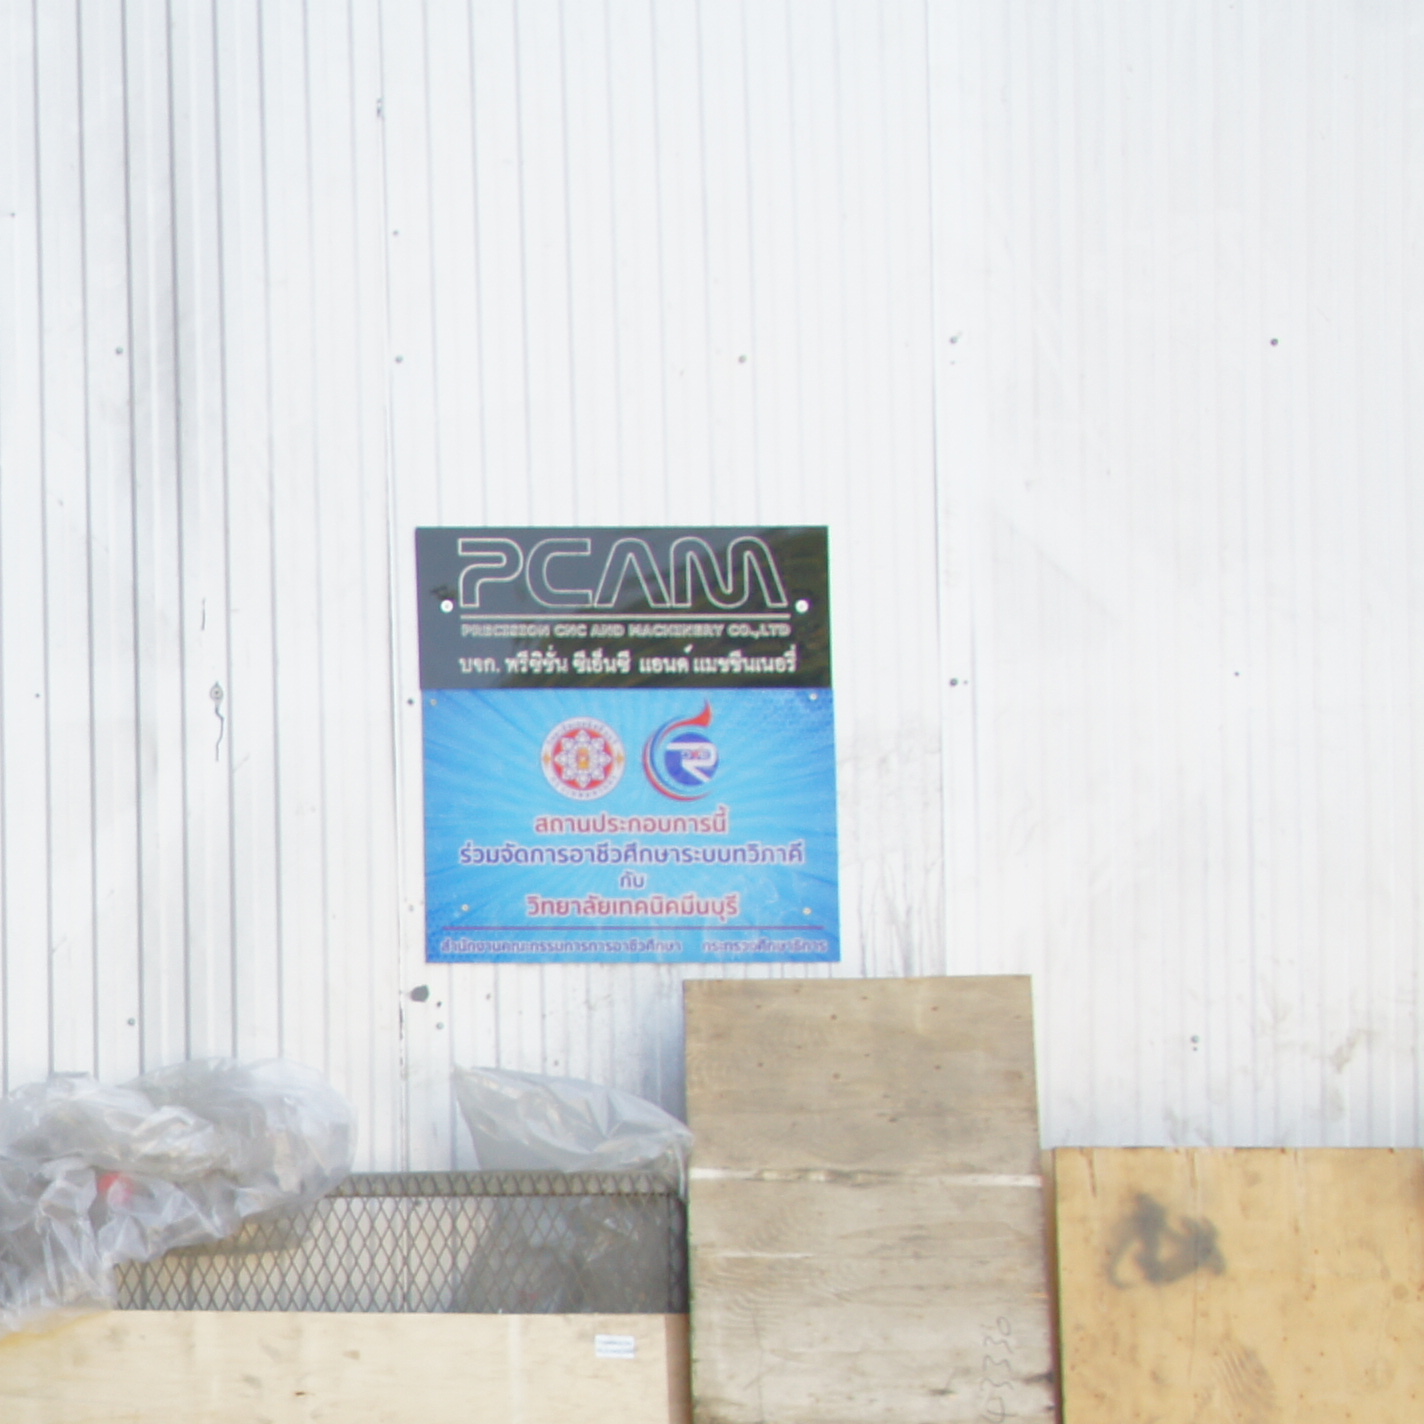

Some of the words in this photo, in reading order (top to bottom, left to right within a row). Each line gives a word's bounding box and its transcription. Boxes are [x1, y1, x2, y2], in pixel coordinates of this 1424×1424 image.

[457, 536, 789, 608] PCAM
[461, 623, 550, 638] PRECISION
[554, 623, 587, 638] CNC
[590, 623, 625, 638] AND
[628, 623, 725, 638] MACHINERY
[534, 806, 728, 834] สถานประกอบการนี้
[619, 871, 645, 889] กับ
[527, 893, 740, 922] วิทยาลัยเทคนิคมีนบุรี
